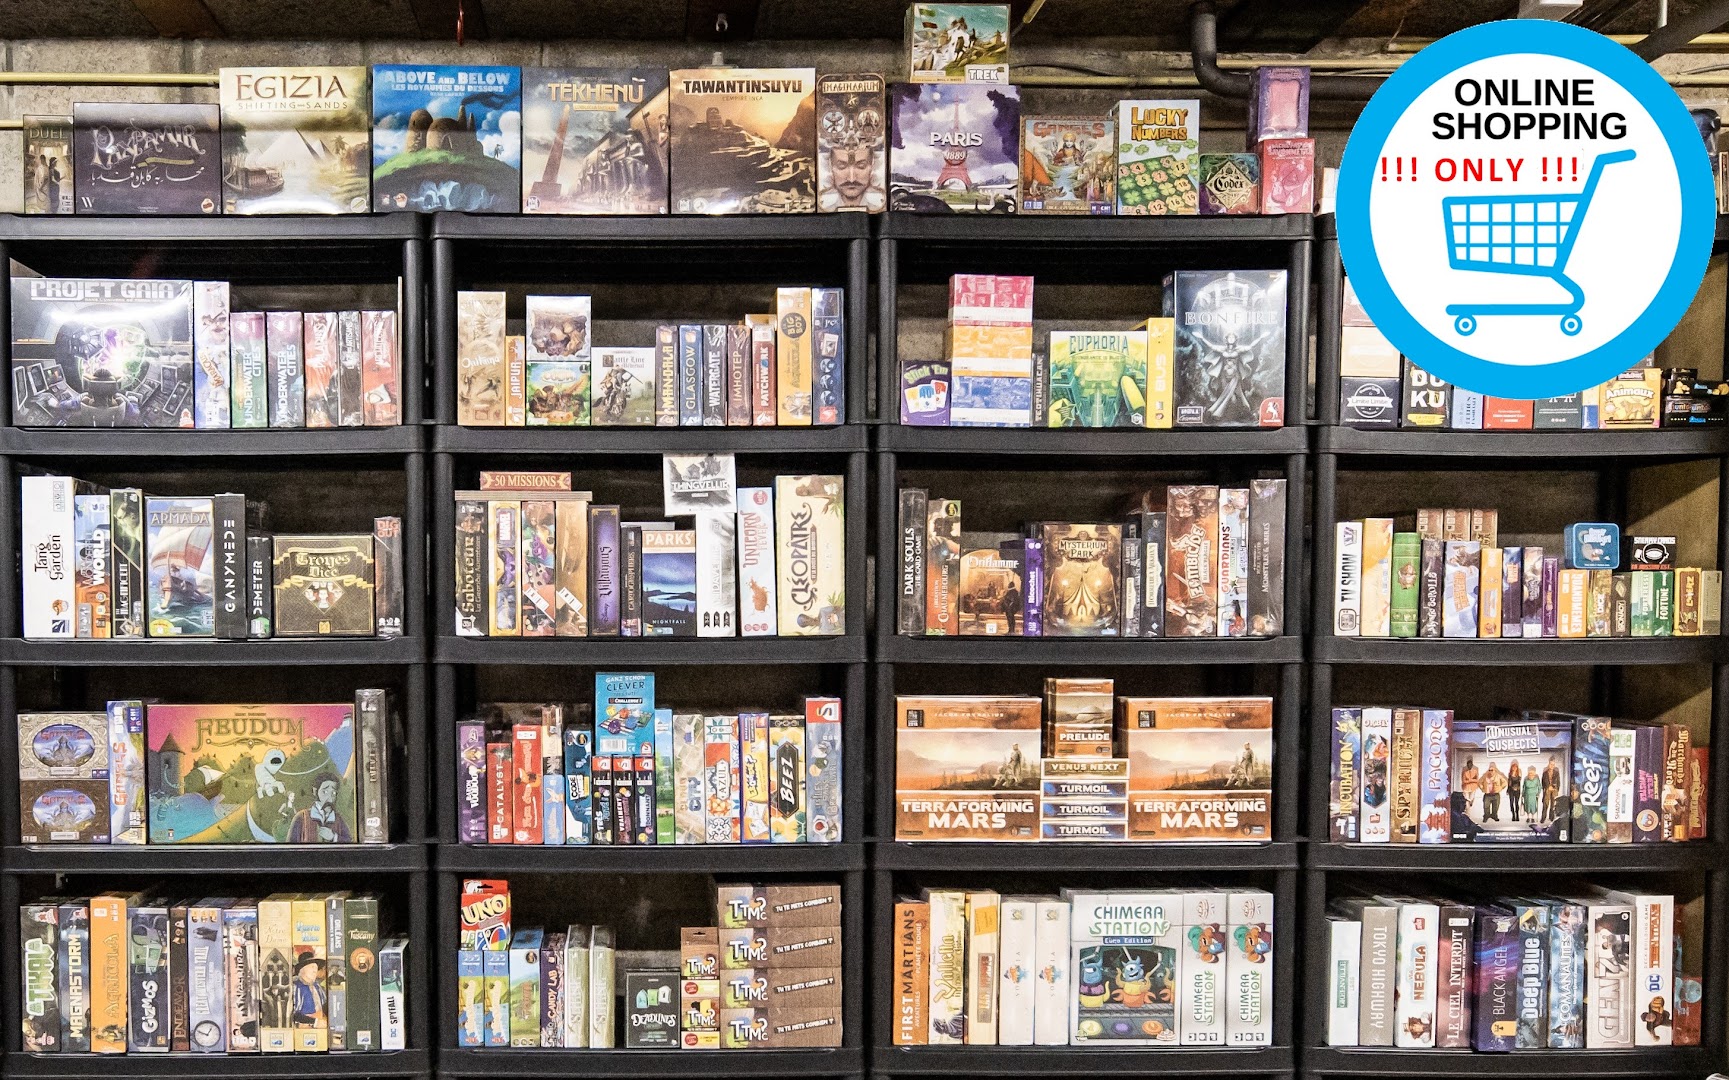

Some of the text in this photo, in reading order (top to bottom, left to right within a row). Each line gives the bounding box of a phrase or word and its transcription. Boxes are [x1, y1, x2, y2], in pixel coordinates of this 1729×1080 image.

[236, 75, 348, 101] EGIZIA
[385, 70, 436, 84] ABOVE
[458, 72, 511, 85] BELOW
[408, 84, 452, 92] ROYAUMES
[454, 84, 465, 92] DU
[467, 85, 504, 93] DESSOUS
[683, 80, 803, 94] TAWANTINSUYU
[823, 81, 880, 93] IMAGINARIUM
[968, 68, 999, 80] TREK
[239, 101, 348, 110] SHIFTING SANDS
[1131, 106, 1189, 126] LUCKY
[29, 127, 66, 139] DUEL
[930, 132, 983, 147] PARIS
[1131, 126, 1188, 142] NUMBERS
[945, 151, 967, 160] 1889
[1214, 173, 1244, 192] Codex
[1153, 204, 1163, 212] 12
[31, 281, 175, 300] PROJET GAIA
[786, 318, 794, 335] BIG
[1186, 311, 1278, 326] BONFIRE
[1070, 336, 1130, 354] EUPHORIA
[252, 346, 262, 377] CITIES
[286, 344, 296, 377] CITIES
[1156, 354, 1167, 393] BUS
[242, 352, 253, 427] UNDERWATER
[277, 351, 288, 424] UNDERWATER
[511, 362, 523, 399] JAIPUR
[662, 346, 675, 410] MANDALA
[686, 346, 696, 410] GLASGOW
[709, 350, 721, 408] WATERGATE
[733, 350, 743, 402] IMHOTEP
[760, 347, 770, 407] PATCHWORK
[1035, 358, 1044, 423] TEOTIHUACAN
[1411, 390, 1446, 408] KU
[1605, 387, 1654, 399] Animaux
[494, 476, 557, 488] 50 MISSIONS
[672, 481, 730, 490] THINGVELLIR
[151, 513, 210, 525] ARMADA
[377, 520, 399, 530] DIG
[377, 530, 399, 538] OUT
[646, 533, 692, 546] PARKS
[742, 510, 760, 568] UNICORN
[758, 524, 768, 551] FEVER
[1060, 540, 1108, 550] MYSTERIUM
[34, 543, 46, 573] Tang
[46, 535, 64, 580] Garden
[93, 529, 105, 586] WORLD
[224, 520, 236, 613] GANYMEDE
[296, 552, 351, 569] Troyes
[904, 528, 914, 596] DARK SOULS
[968, 555, 1020, 568] Oriflamme
[1071, 549, 1094, 558] PARK
[1185, 525, 1206, 599] ZOMBICIDE
[1221, 526, 1231, 593] GUARDIANS
[309, 566, 338, 578] Dice
[462, 536, 475, 613] Saboteur
[600, 546, 612, 598] Villainous
[1341, 554, 1357, 603] TV SHOW
[120, 563, 128, 615] MAGNIFICENT
[253, 561, 263, 615] DEMETER
[938, 565, 949, 622] CHAUMEBOURG
[1028, 571, 1036, 604] Ricochet
[1642, 574, 1650, 615] FORTERESSE
[1660, 588, 1668, 620] FORTUNE
[606, 682, 646, 691] CLEVER
[192, 717, 311, 752] FEUDUM
[1060, 733, 1110, 742] PRELUDE
[1487, 726, 1532, 739] UNUSUAL
[1489, 738, 1538, 752] SUSPECTS
[1090, 763, 1120, 771] NEXT
[1429, 718, 1443, 790] PAGODE
[1666, 749, 1678, 785] du Nord
[1677, 730, 1688, 784] Marchands
[570, 776, 578, 799] CODE
[718, 766, 727, 796] AZUL
[780, 757, 794, 806] BEEZ
[1061, 784, 1110, 793] TURMOIL
[1340, 741, 1354, 816] INCUBATION
[1580, 757, 1603, 806] Reef
[688, 777, 702, 812] CITY
[902, 802, 1034, 813] TERRAFORMING
[1060, 805, 1110, 814] TURMOIL
[1134, 801, 1266, 812] TERRAFORMING
[616, 798, 624, 831] VRAIMENT
[928, 813, 1007, 829] MARS
[1160, 813, 1239, 828] MARS
[1060, 826, 1110, 834] TURMOIL
[462, 894, 508, 925] UNO
[791, 902, 804, 910] METS
[804, 898, 827, 907] COMBIEN
[1094, 906, 1164, 920] CHIMERA
[334, 920, 342, 948] ORLÉANS
[348, 928, 376, 943] Tuscany
[1089, 921, 1166, 936] STATION
[1450, 930, 1464, 987] INTERDIT
[1522, 937, 1542, 976] Blue
[69, 934, 84, 1039] MAGNASTORM
[103, 934, 120, 1019] AGRICOLA
[902, 909, 914, 1040] FIRST MARTIANS
[1370, 926, 1388, 1029] TOKYO HIGHWAY
[1414, 945, 1426, 1001] NEBULA
[1493, 946, 1508, 1016] BLACK ANGEL
[1560, 934, 1572, 1022] COMANAUTES
[1649, 974, 1661, 992] DC
[174, 975, 186, 1039] ENDEAVOR
[548, 970, 557, 1020] CANDY LAB
[1194, 974, 1204, 1021] CHIMERA
[1204, 970, 1215, 1026] STATION
[1240, 974, 1250, 1021] CHIMERA
[1250, 970, 1262, 1026] STATION
[1449, 994, 1460, 1020] CIEL
[1522, 980, 1542, 1019] Deep
[388, 996, 398, 1038] DC SPYFALL
[1447, 1021, 1460, 1040] LE
